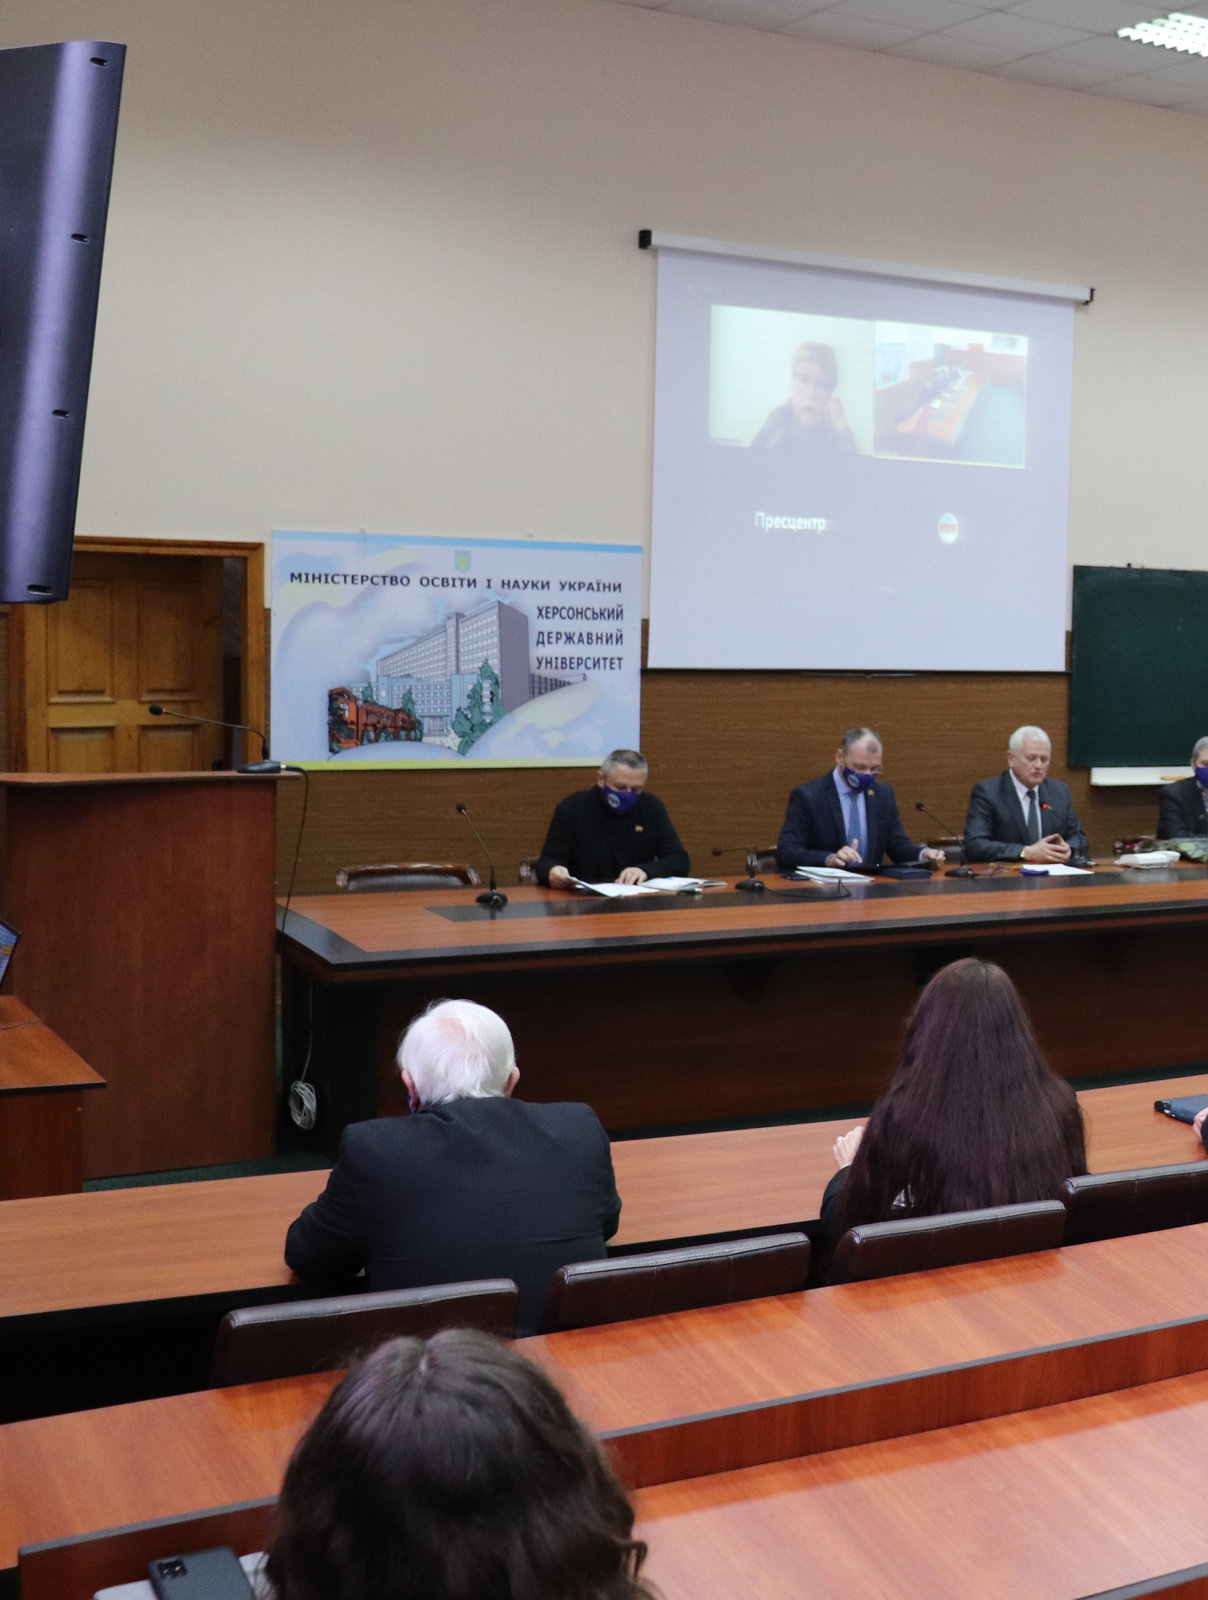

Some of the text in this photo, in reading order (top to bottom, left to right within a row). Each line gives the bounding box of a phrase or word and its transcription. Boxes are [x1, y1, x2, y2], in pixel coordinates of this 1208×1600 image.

[755, 511, 827, 534] Пресцентр
[289, 572, 622, 593] МІНІСТЕРСТВО ОСВІТИ І НАУКИ УКРАЇНИ
[536, 604, 624, 621] ХЕРСОНСЬКИЙ
[536, 629, 624, 646] ДЕРЖАВНИЙ
[536, 656, 624, 670] УНІВЕРСИТЕТ
